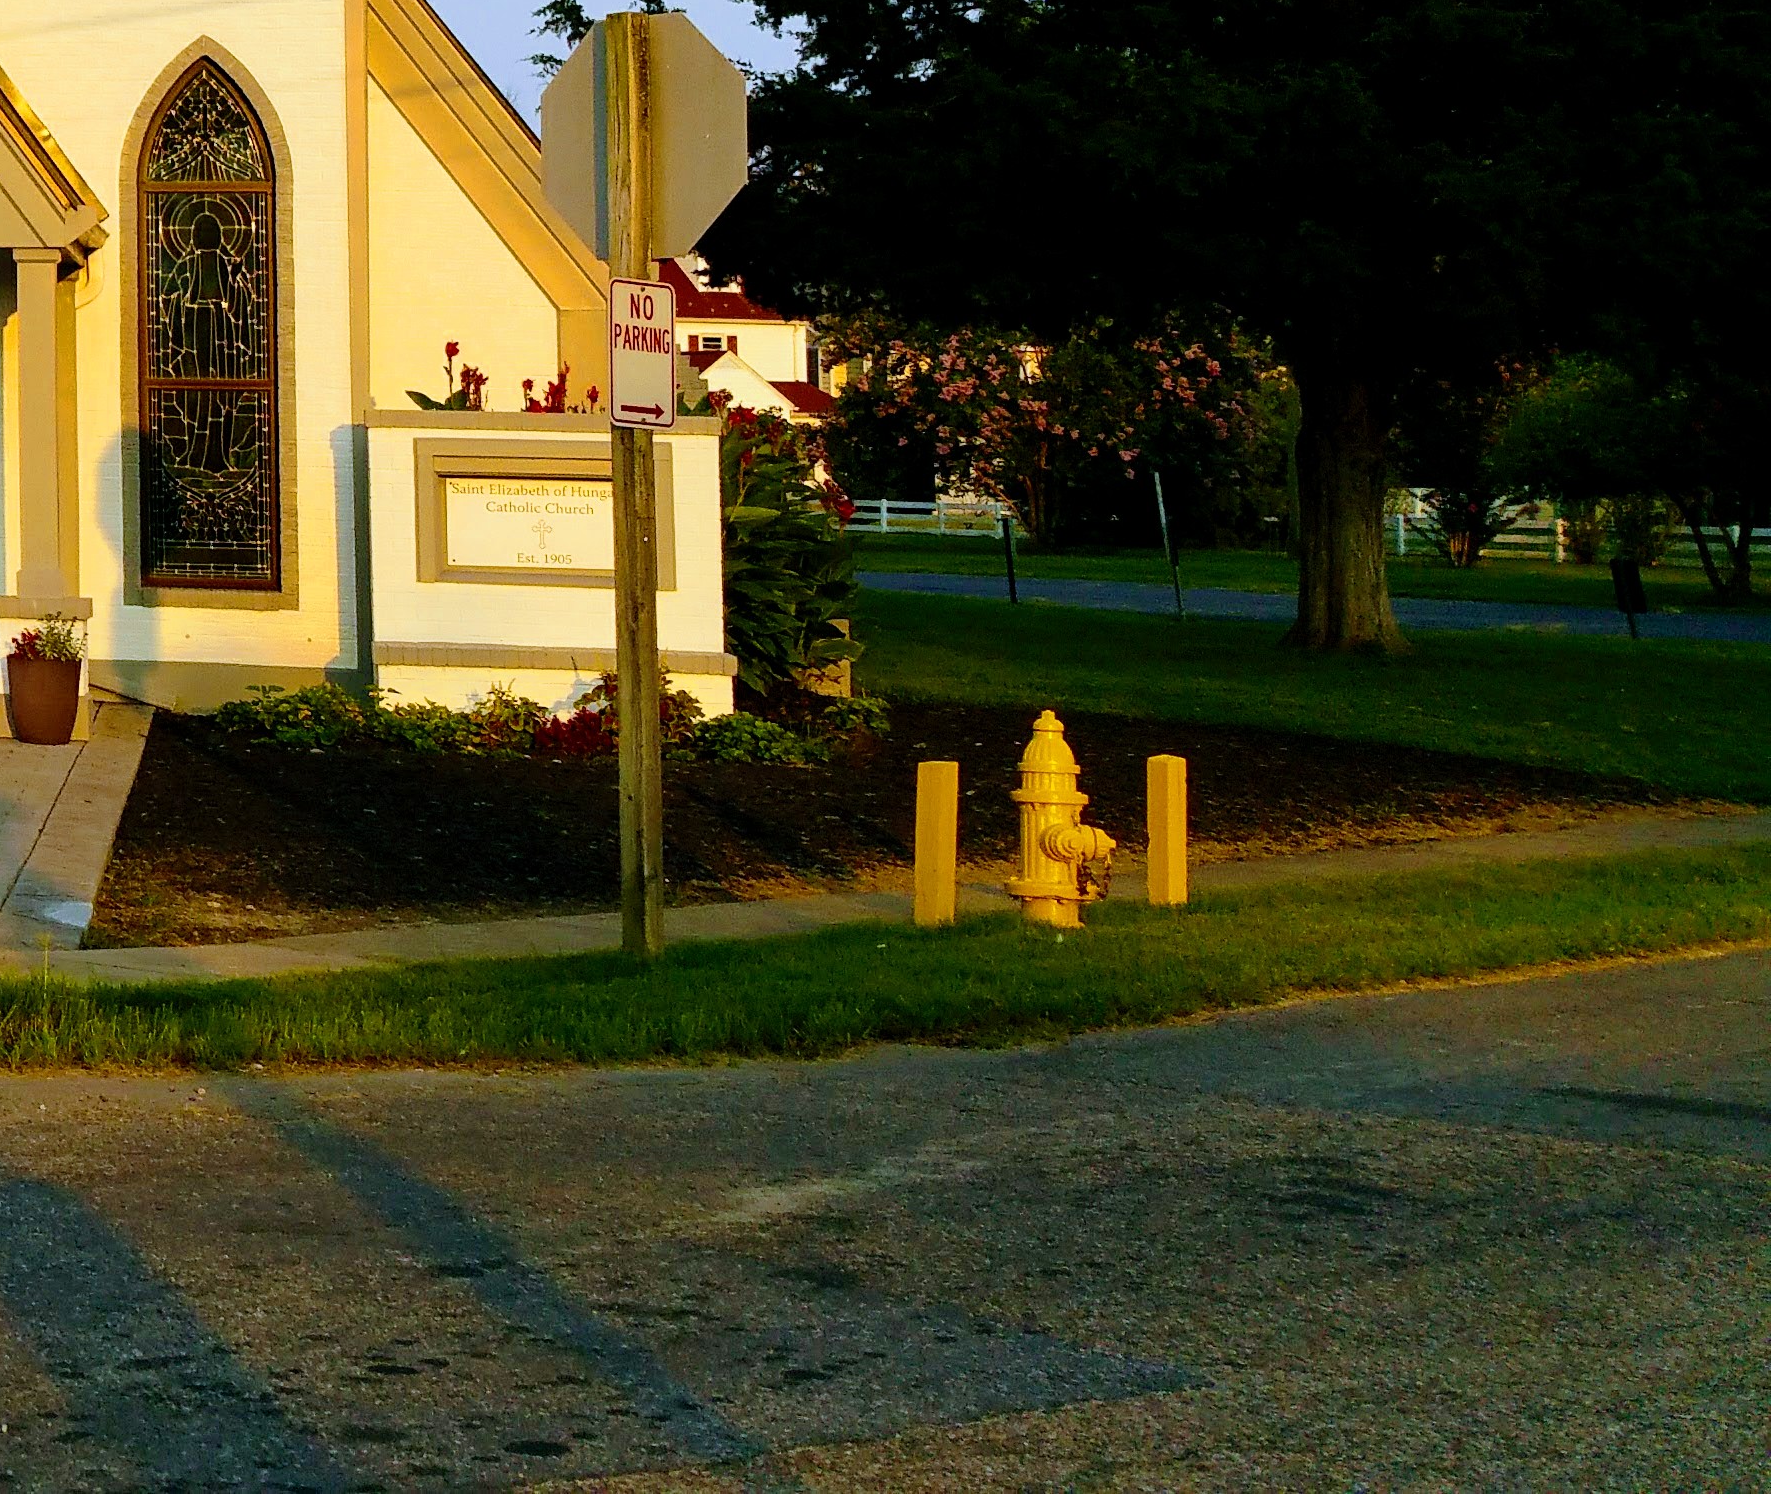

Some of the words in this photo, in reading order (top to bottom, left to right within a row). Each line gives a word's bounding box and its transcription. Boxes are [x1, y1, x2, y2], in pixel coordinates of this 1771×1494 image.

[630, 293, 654, 321] NO
[614, 323, 670, 354] PARKING
[451, 483, 484, 495] Saint
[489, 483, 550, 497] Elizabeth
[554, 485, 568, 497] of
[571, 486, 613, 501] Hunga
[486, 501, 541, 514] Catholic
[545, 502, 594, 515] Church
[517, 552, 539, 564] Est.
[544, 553, 572, 565] 1905
